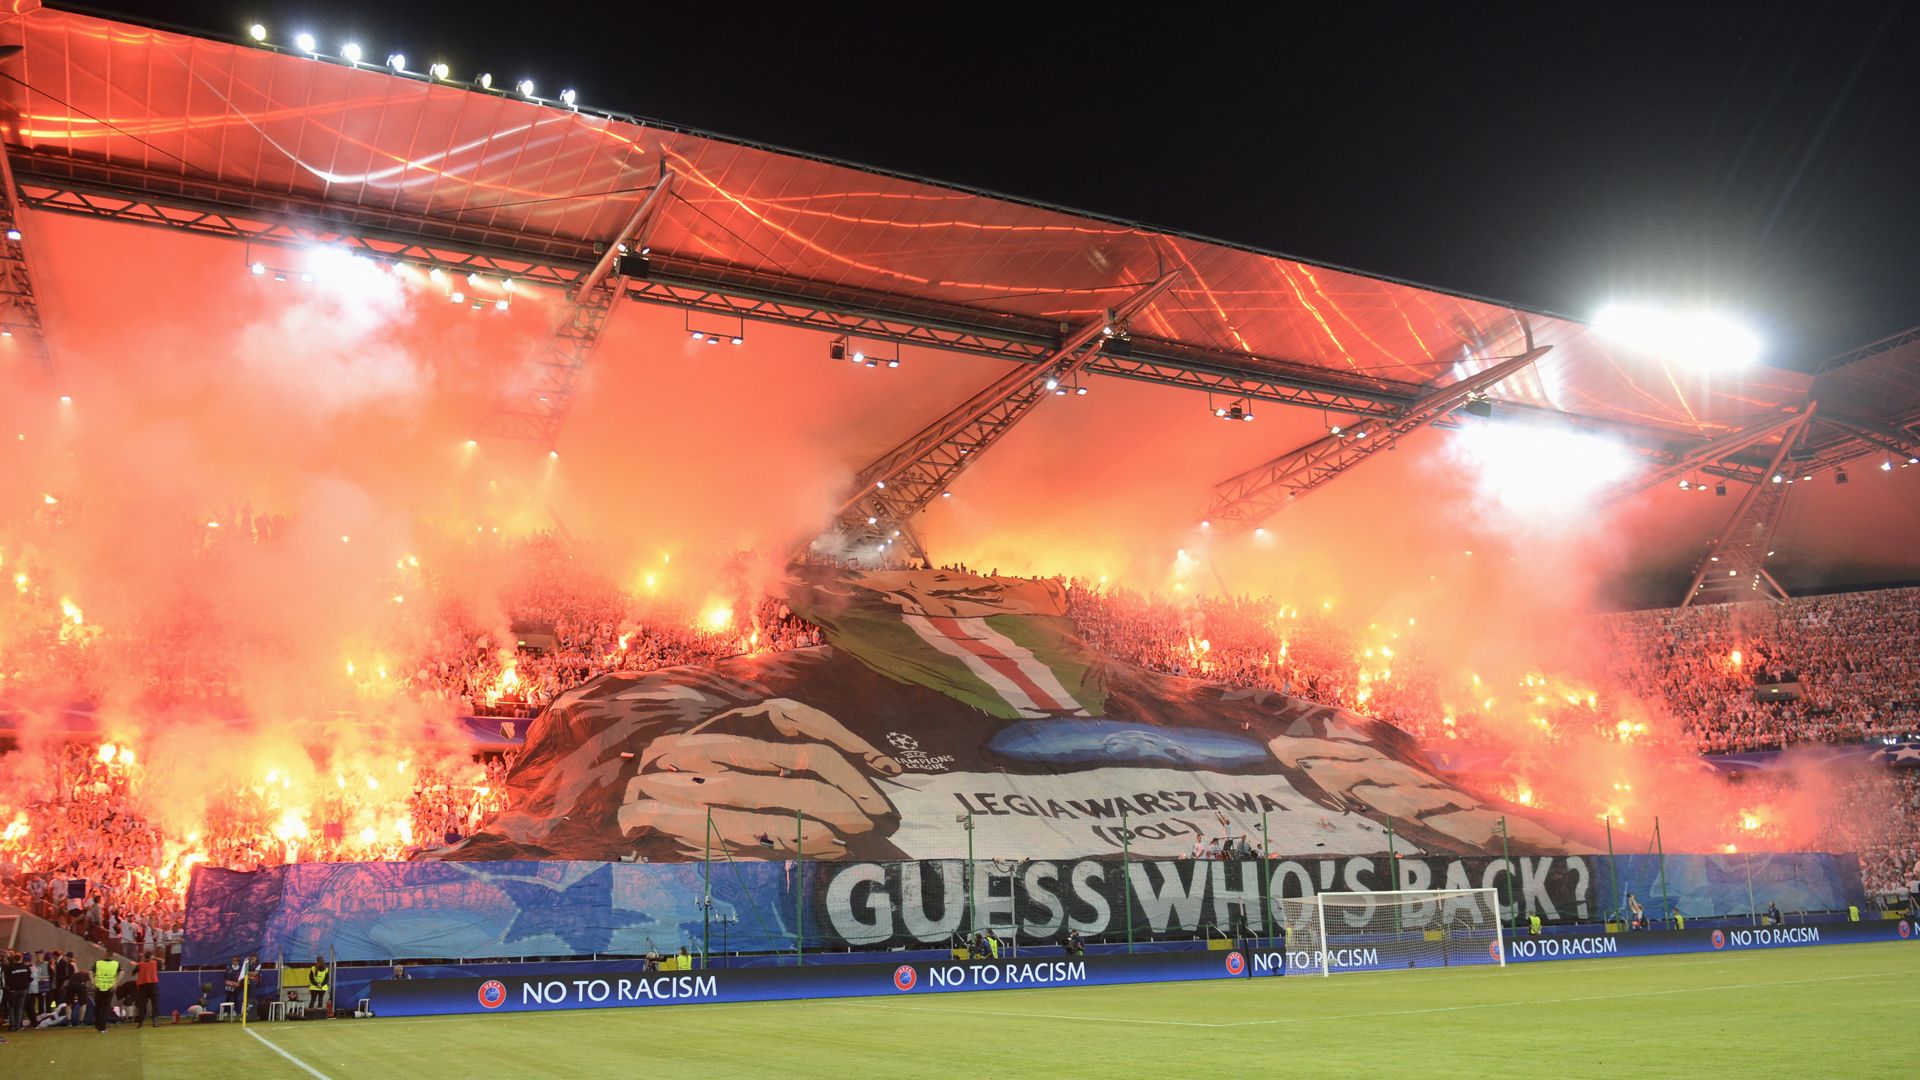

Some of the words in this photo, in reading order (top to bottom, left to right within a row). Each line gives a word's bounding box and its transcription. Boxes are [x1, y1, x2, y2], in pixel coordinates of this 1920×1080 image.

[894, 755, 955, 765] AMPIONS
[953, 791, 1081, 820] LEGIA
[1066, 790, 1292, 820] WARSZAWA
[1091, 817, 1206, 848] (POL)
[826, 859, 1112, 945] GUESS
[1127, 856, 1379, 934] WHO'S
[1512, 941, 1537, 958] NO
[1538, 940, 1560, 956] TO
[1562, 937, 1617, 955] RACISM
[1731, 931, 1752, 947] NO
[1753, 930, 1772, 945] TO
[1774, 927, 1820, 944] RACISM
[929, 966, 965, 987] NO
[970, 965, 1000, 985] TO
[1005, 961, 1086, 984] RACISM
[1254, 952, 1282, 971] NO
[1286, 951, 1309, 969] TO
[522, 980, 567, 1005] NO
[573, 978, 610, 1002] TO
[618, 975, 718, 1000] RACISM
